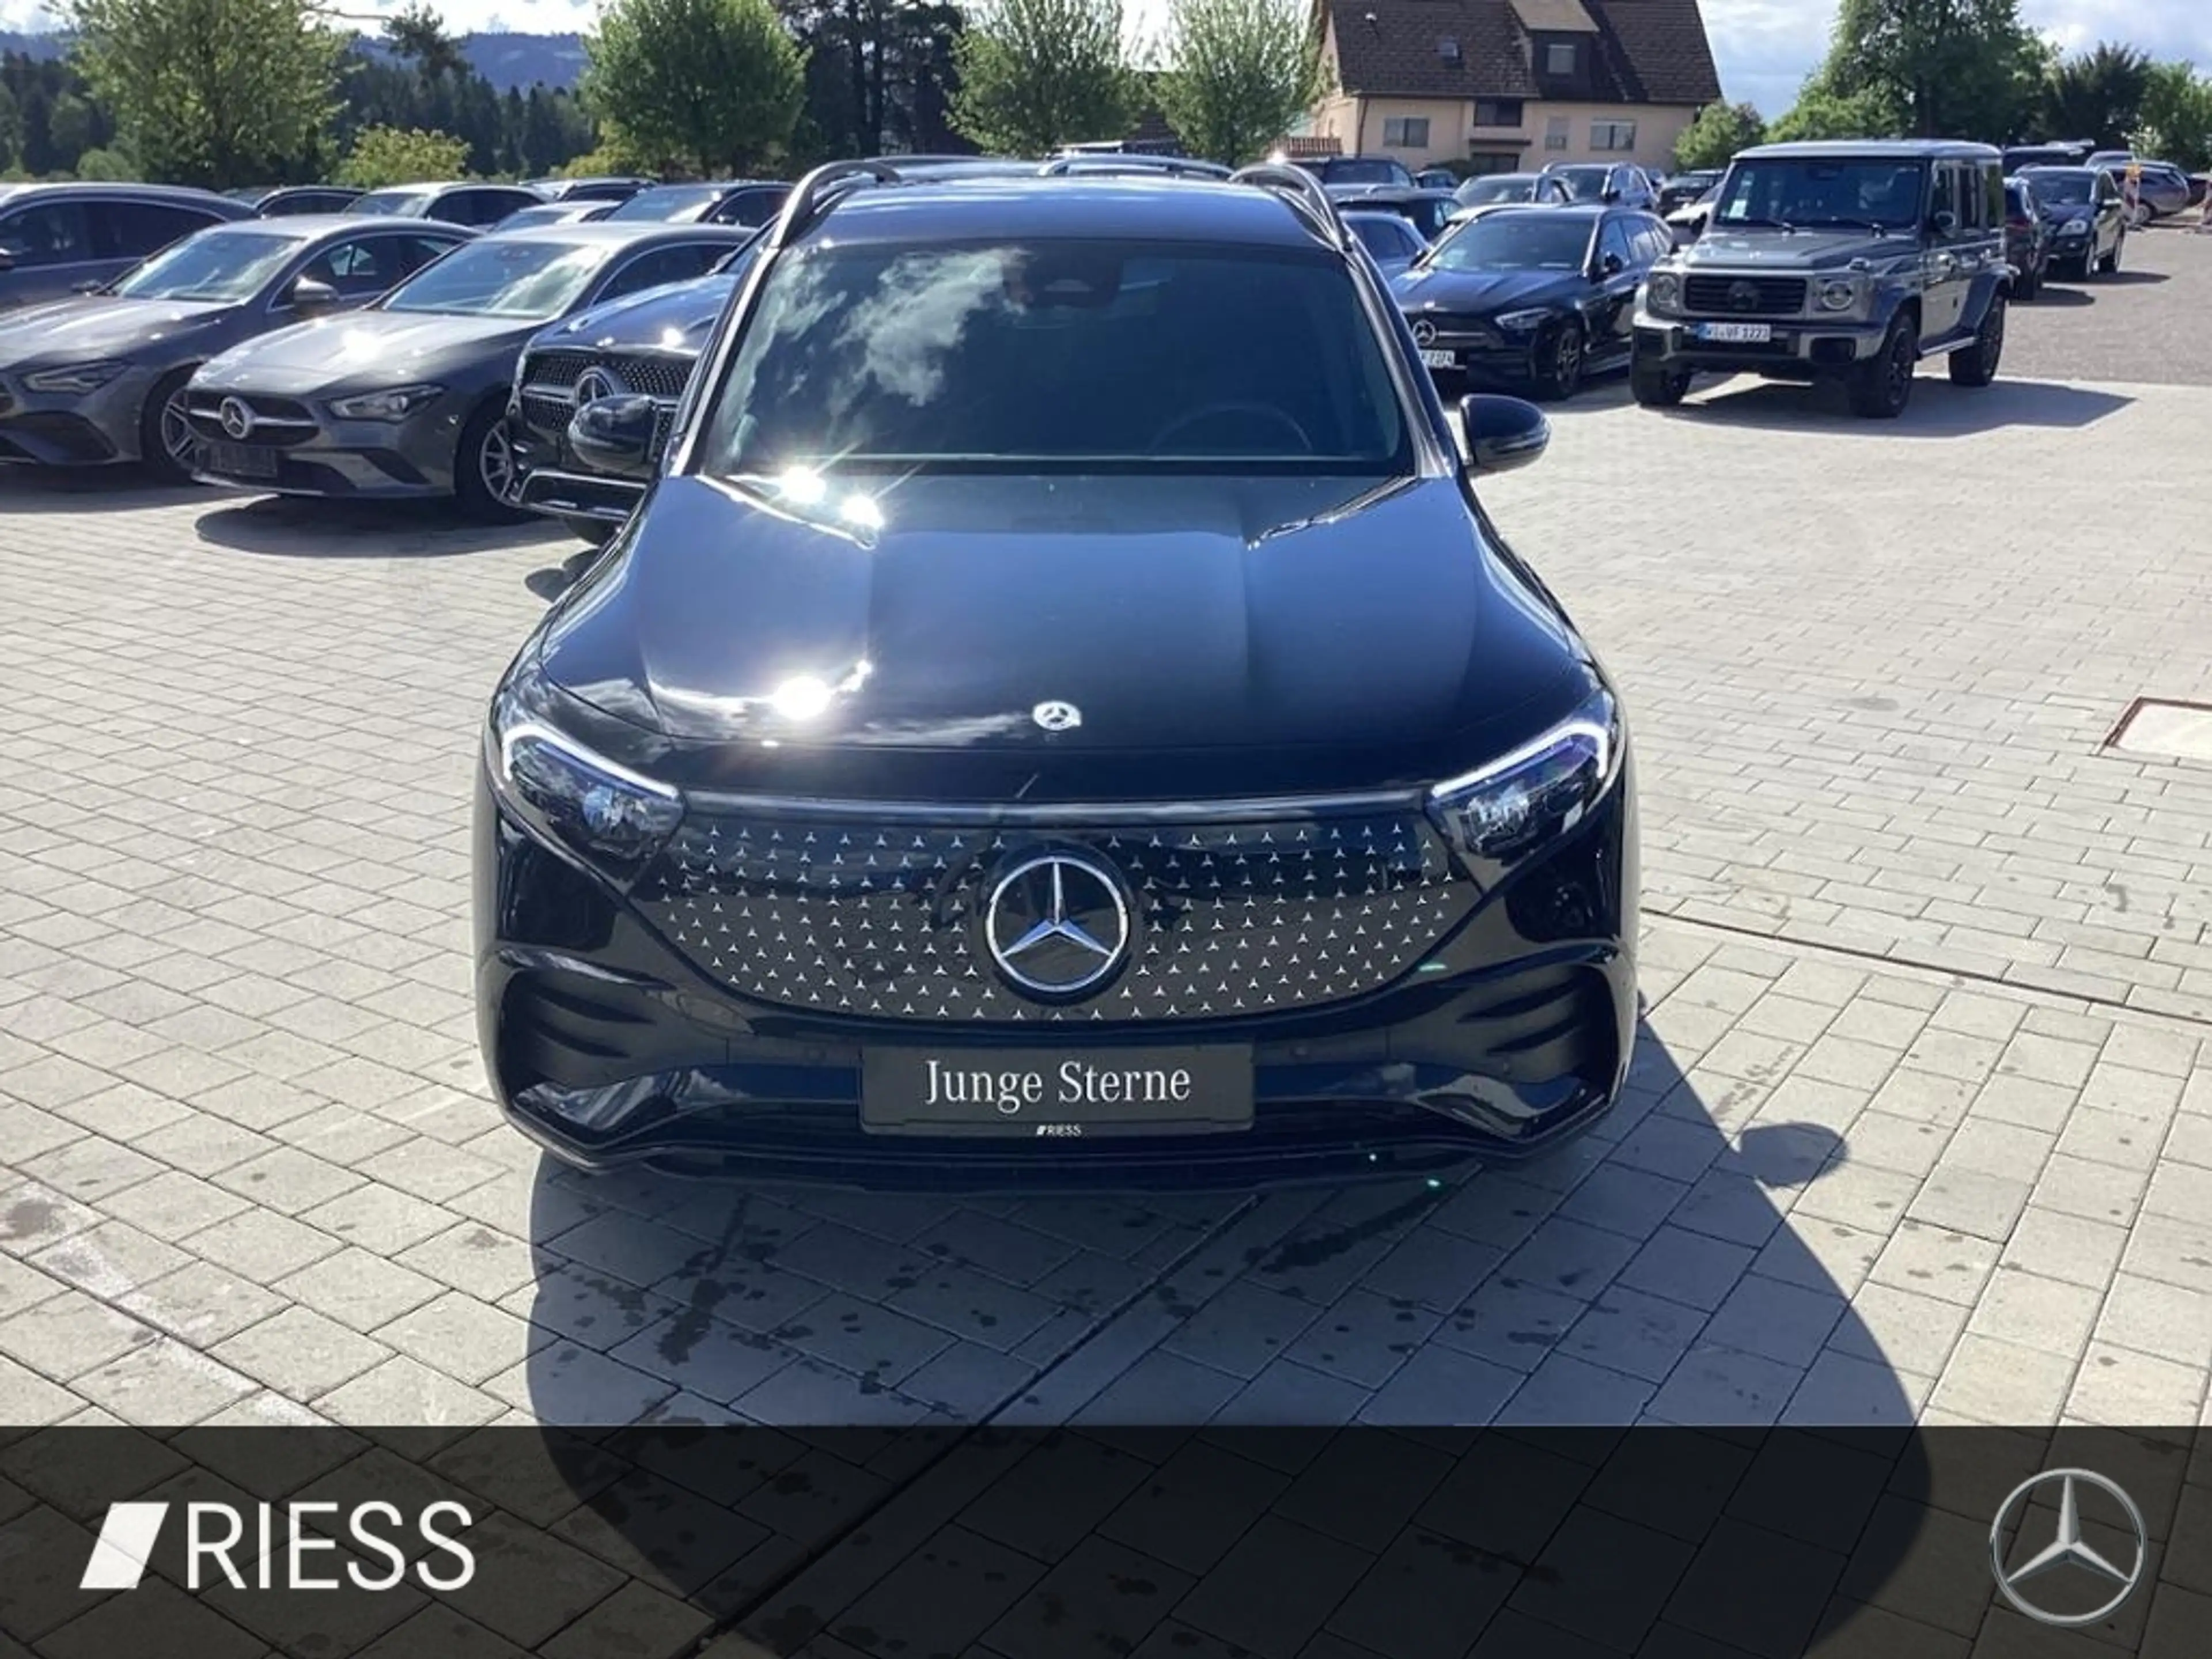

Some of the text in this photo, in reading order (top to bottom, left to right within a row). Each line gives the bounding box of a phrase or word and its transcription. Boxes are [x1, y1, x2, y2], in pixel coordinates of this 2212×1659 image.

[925, 1060, 1191, 1114] Junge Sterne
[1047, 1123, 1082, 1137] RIESS
